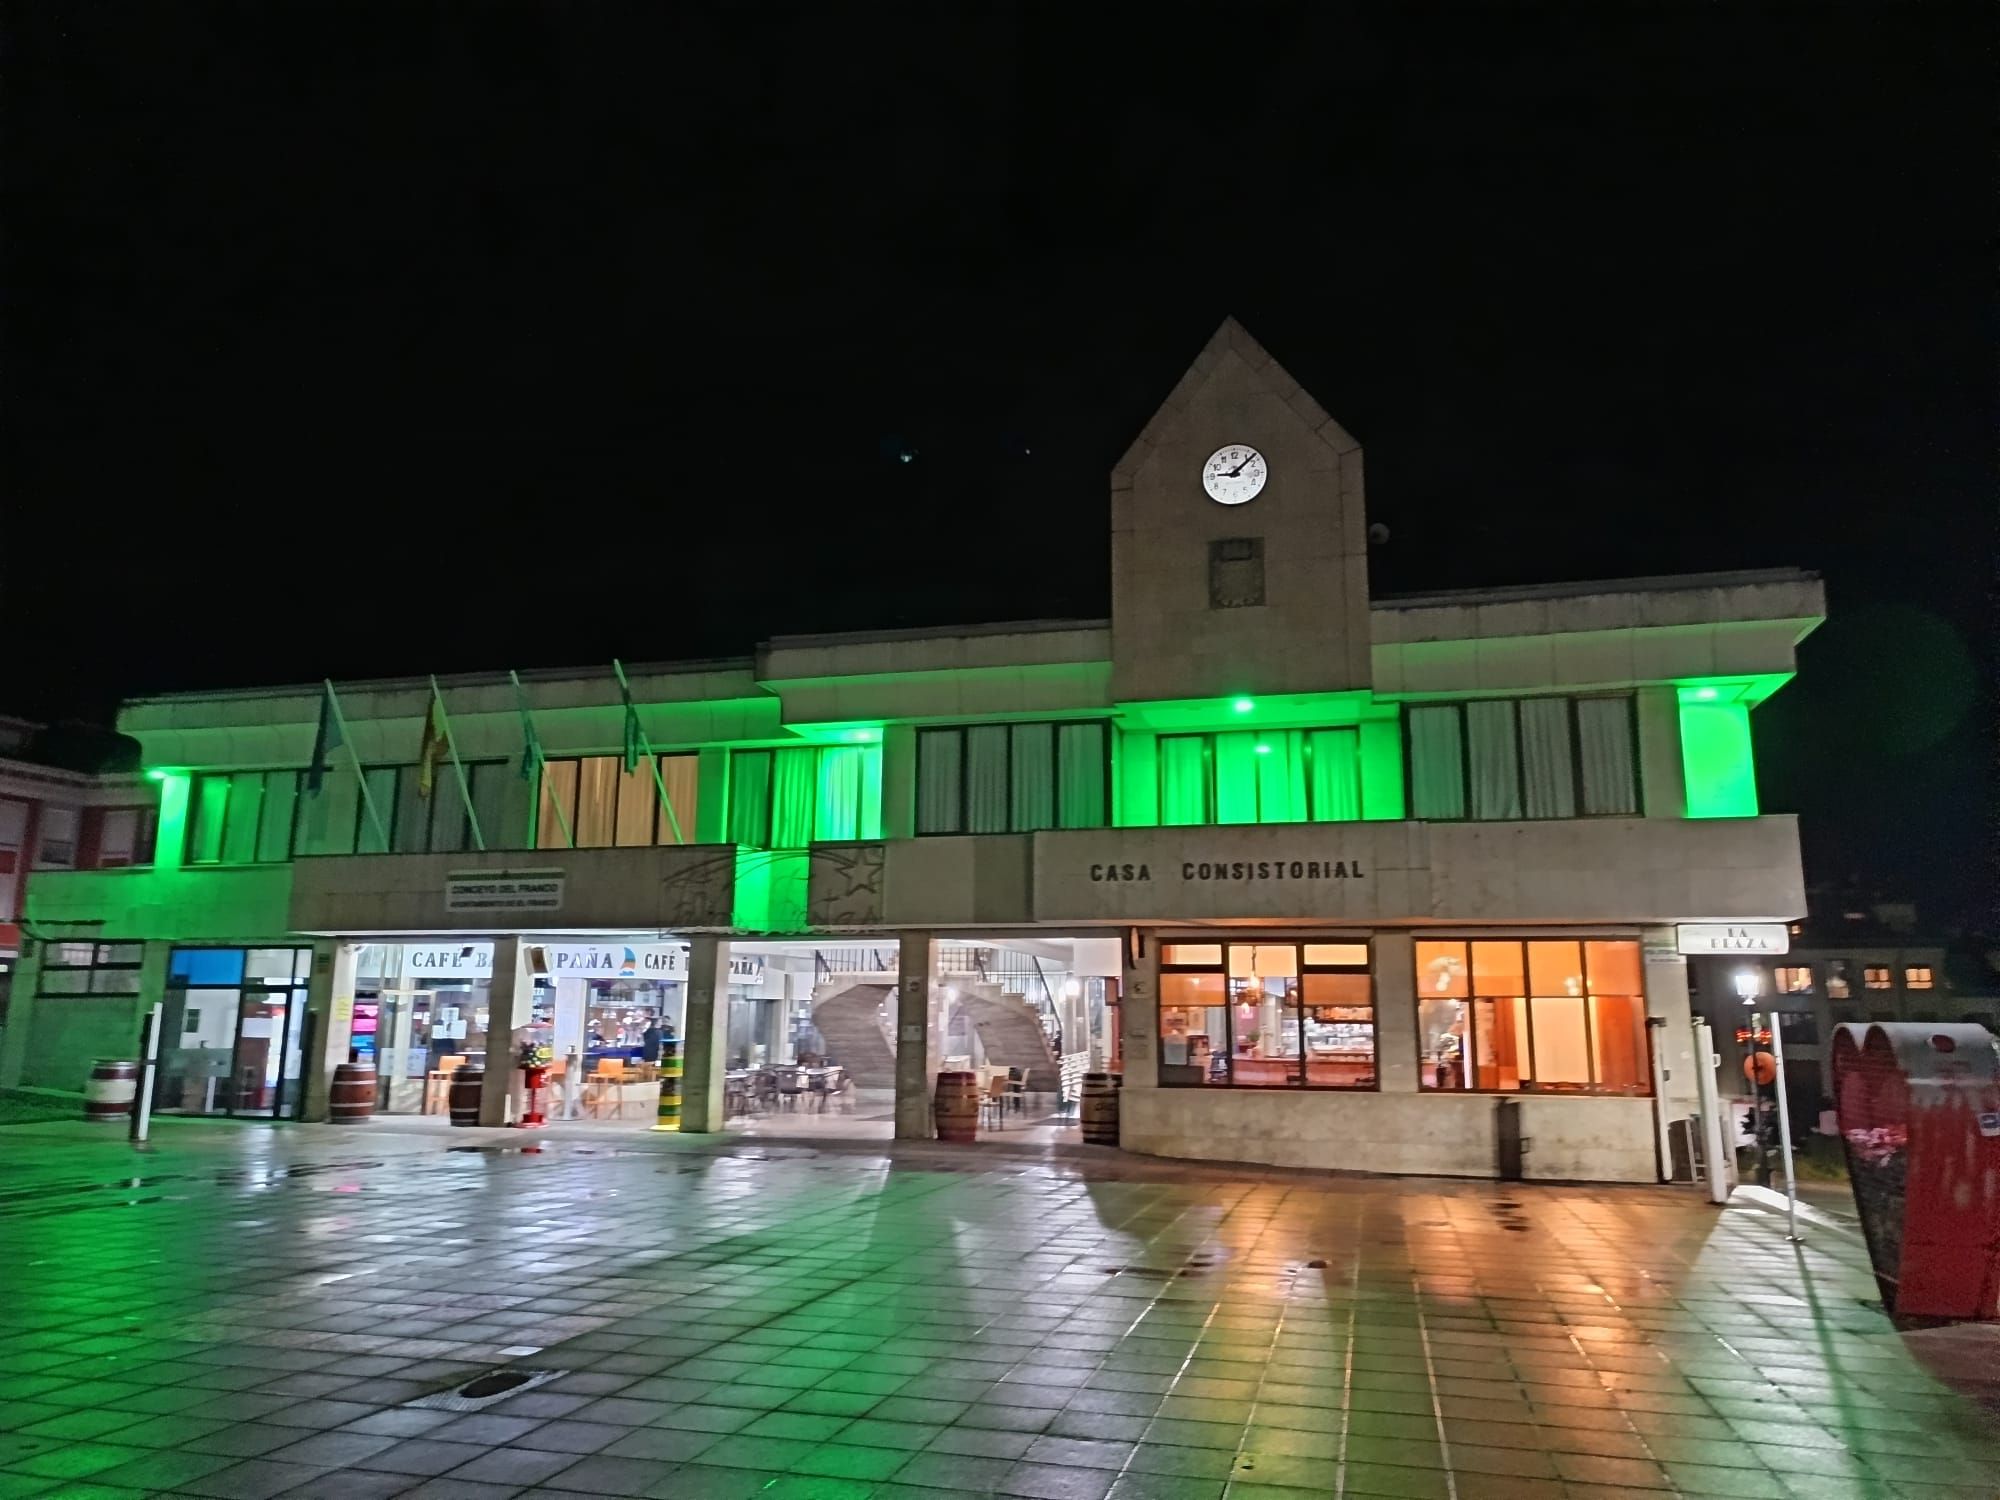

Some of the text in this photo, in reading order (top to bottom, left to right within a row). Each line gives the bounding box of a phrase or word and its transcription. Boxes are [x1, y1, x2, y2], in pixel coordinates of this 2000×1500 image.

[1254, 469, 1260, 477] 3
[1090, 860, 1365, 882] CASA CONSISTORIAL
[1728, 928, 1748, 938] LA
[551, 947, 614, 969] PAÑA
[644, 950, 676, 971] CAFÉ
